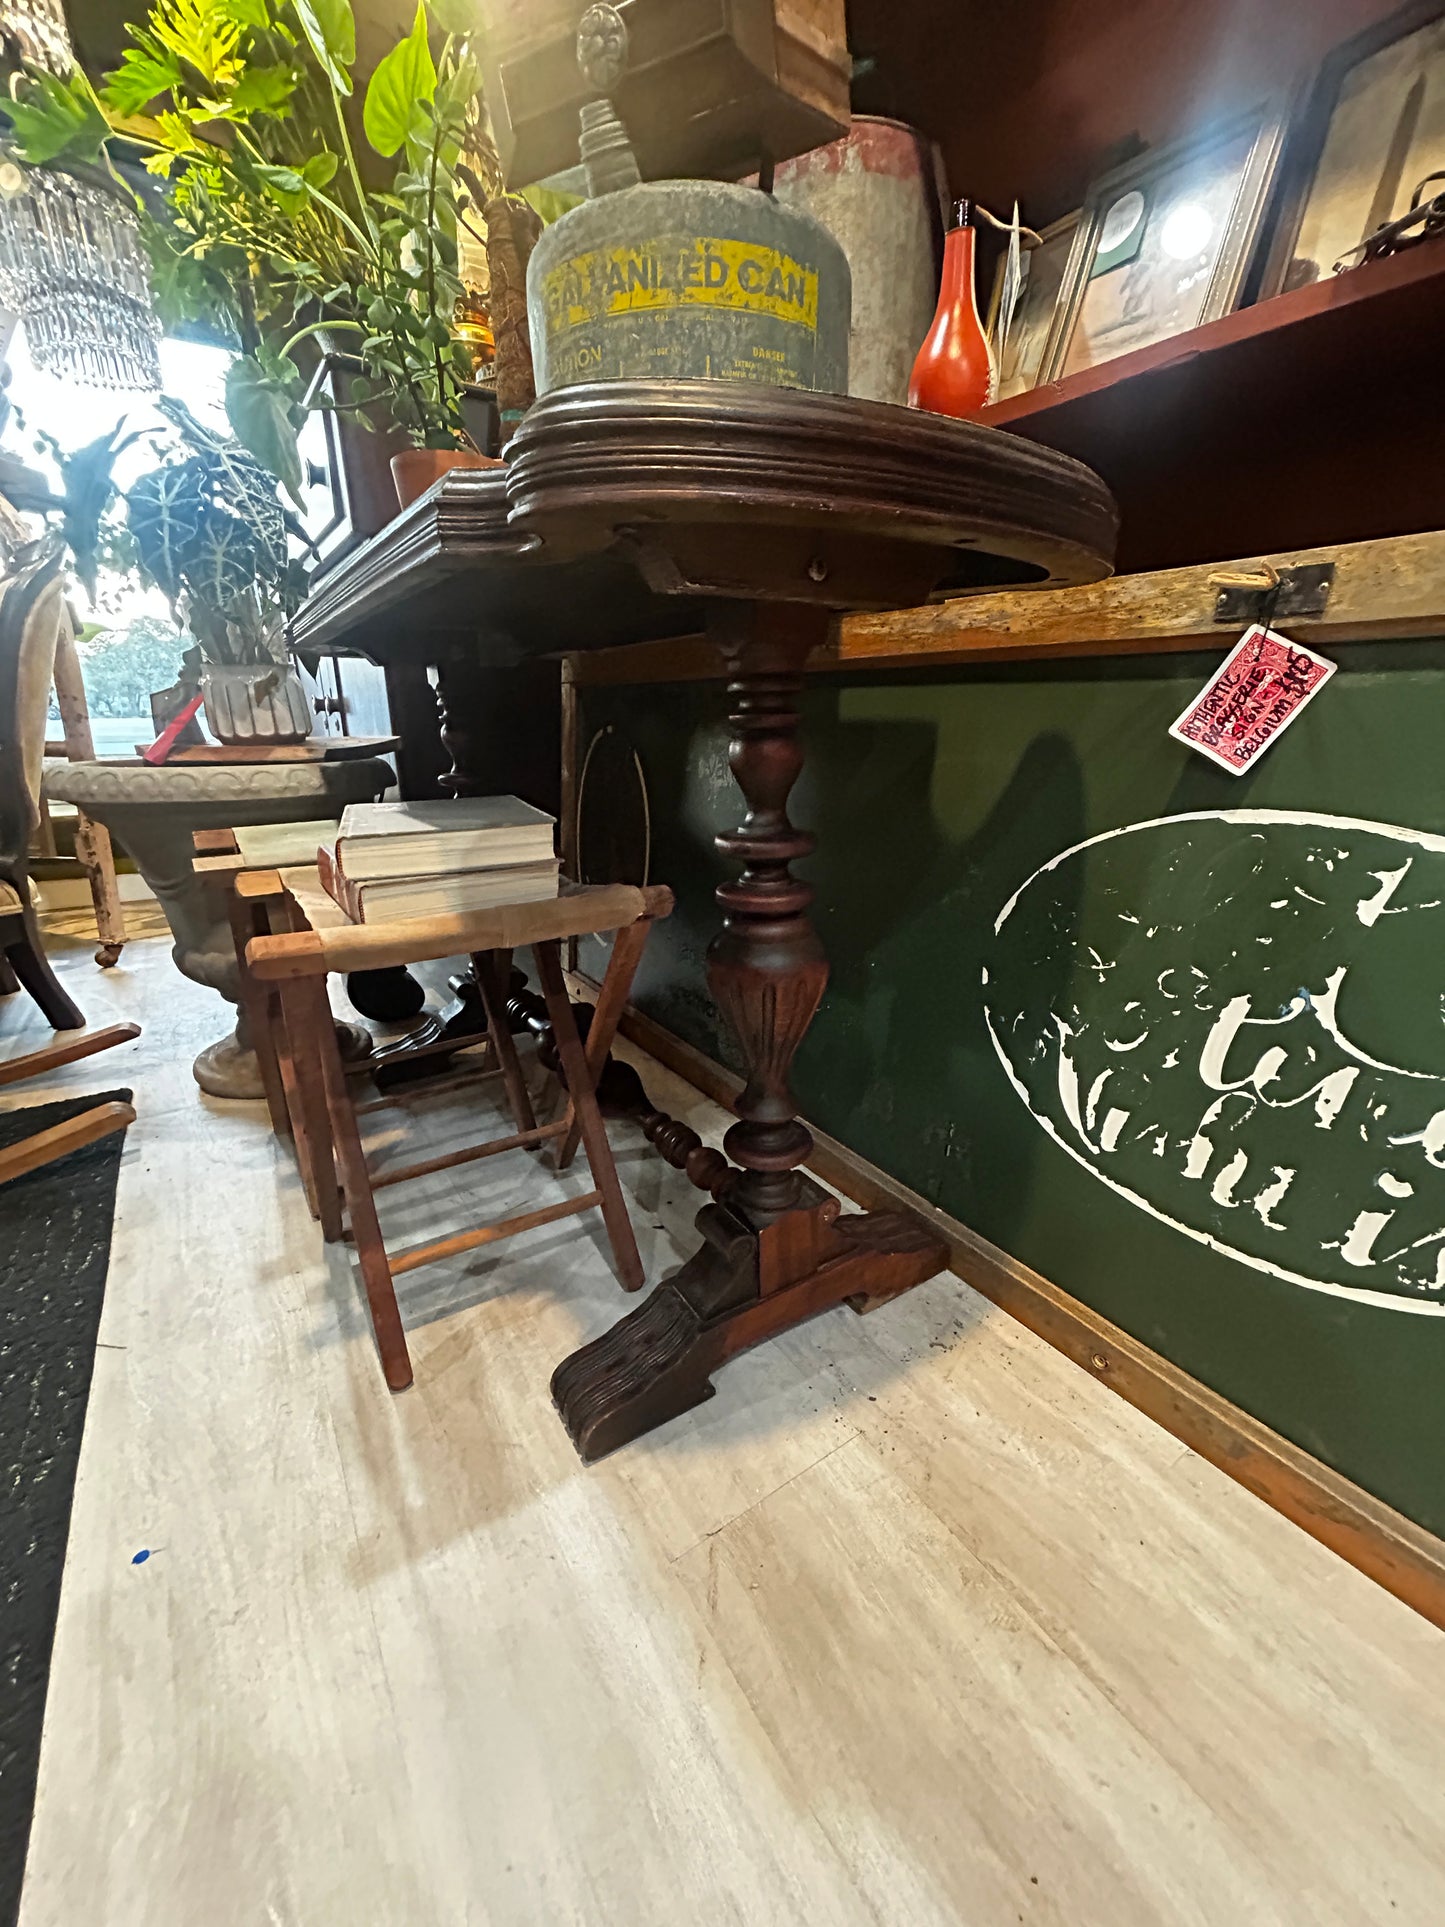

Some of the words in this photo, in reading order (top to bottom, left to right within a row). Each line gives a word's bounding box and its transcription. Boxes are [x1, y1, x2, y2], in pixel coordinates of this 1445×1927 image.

[548, 254, 728, 308] GALANIED
[737, 259, 805, 308] CAN
[550, 344, 602, 380] AUTION
[1180, 673, 1241, 741] AUTHENTIC
[1202, 667, 1267, 747] BRASSERIE
[1234, 698, 1294, 761] BELGIUM
